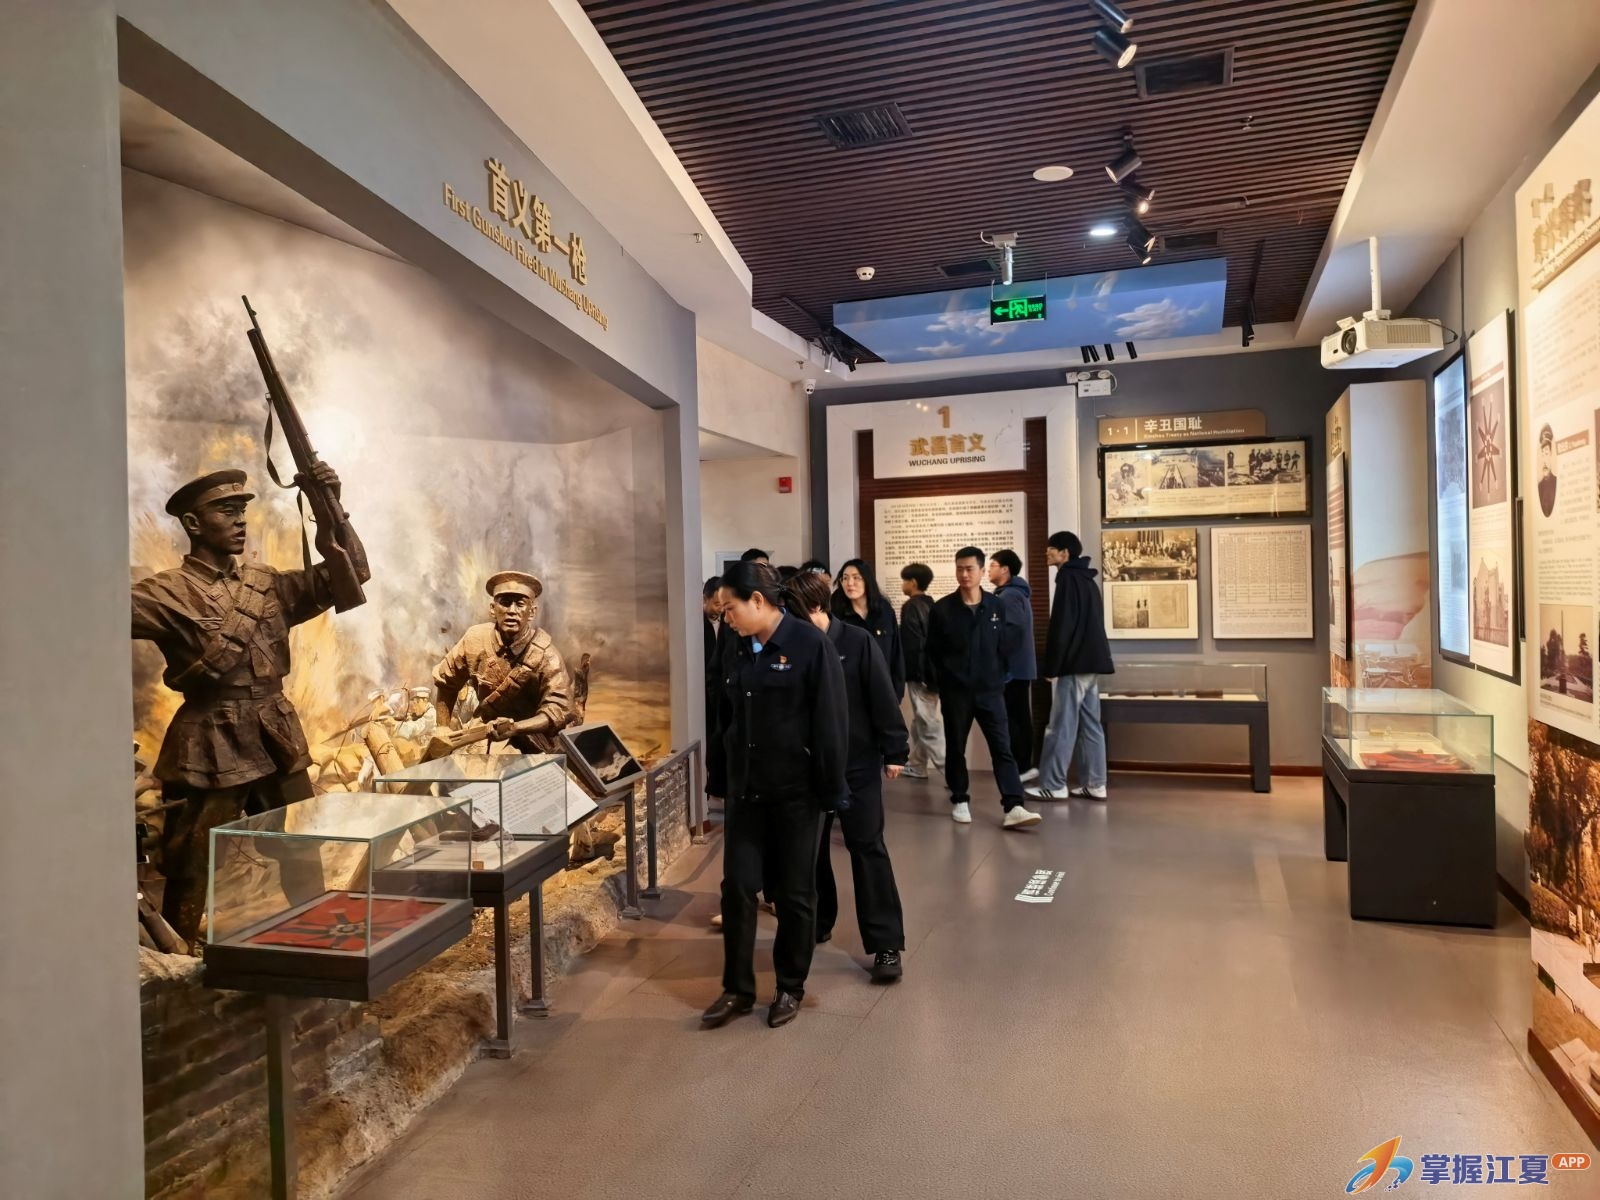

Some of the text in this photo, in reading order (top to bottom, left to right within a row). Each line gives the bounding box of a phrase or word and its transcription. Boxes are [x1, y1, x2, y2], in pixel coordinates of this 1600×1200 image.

[484, 157, 588, 286] 首义第一枪
[443, 182, 609, 331] First Gunshot Fired in Wuchang Uprising
[937, 405, 950, 428] 1
[1144, 416, 1202, 433] 辛丑国耻
[909, 433, 986, 456] 武昌首义
[909, 456, 986, 467] WUCHANG UPRISING
